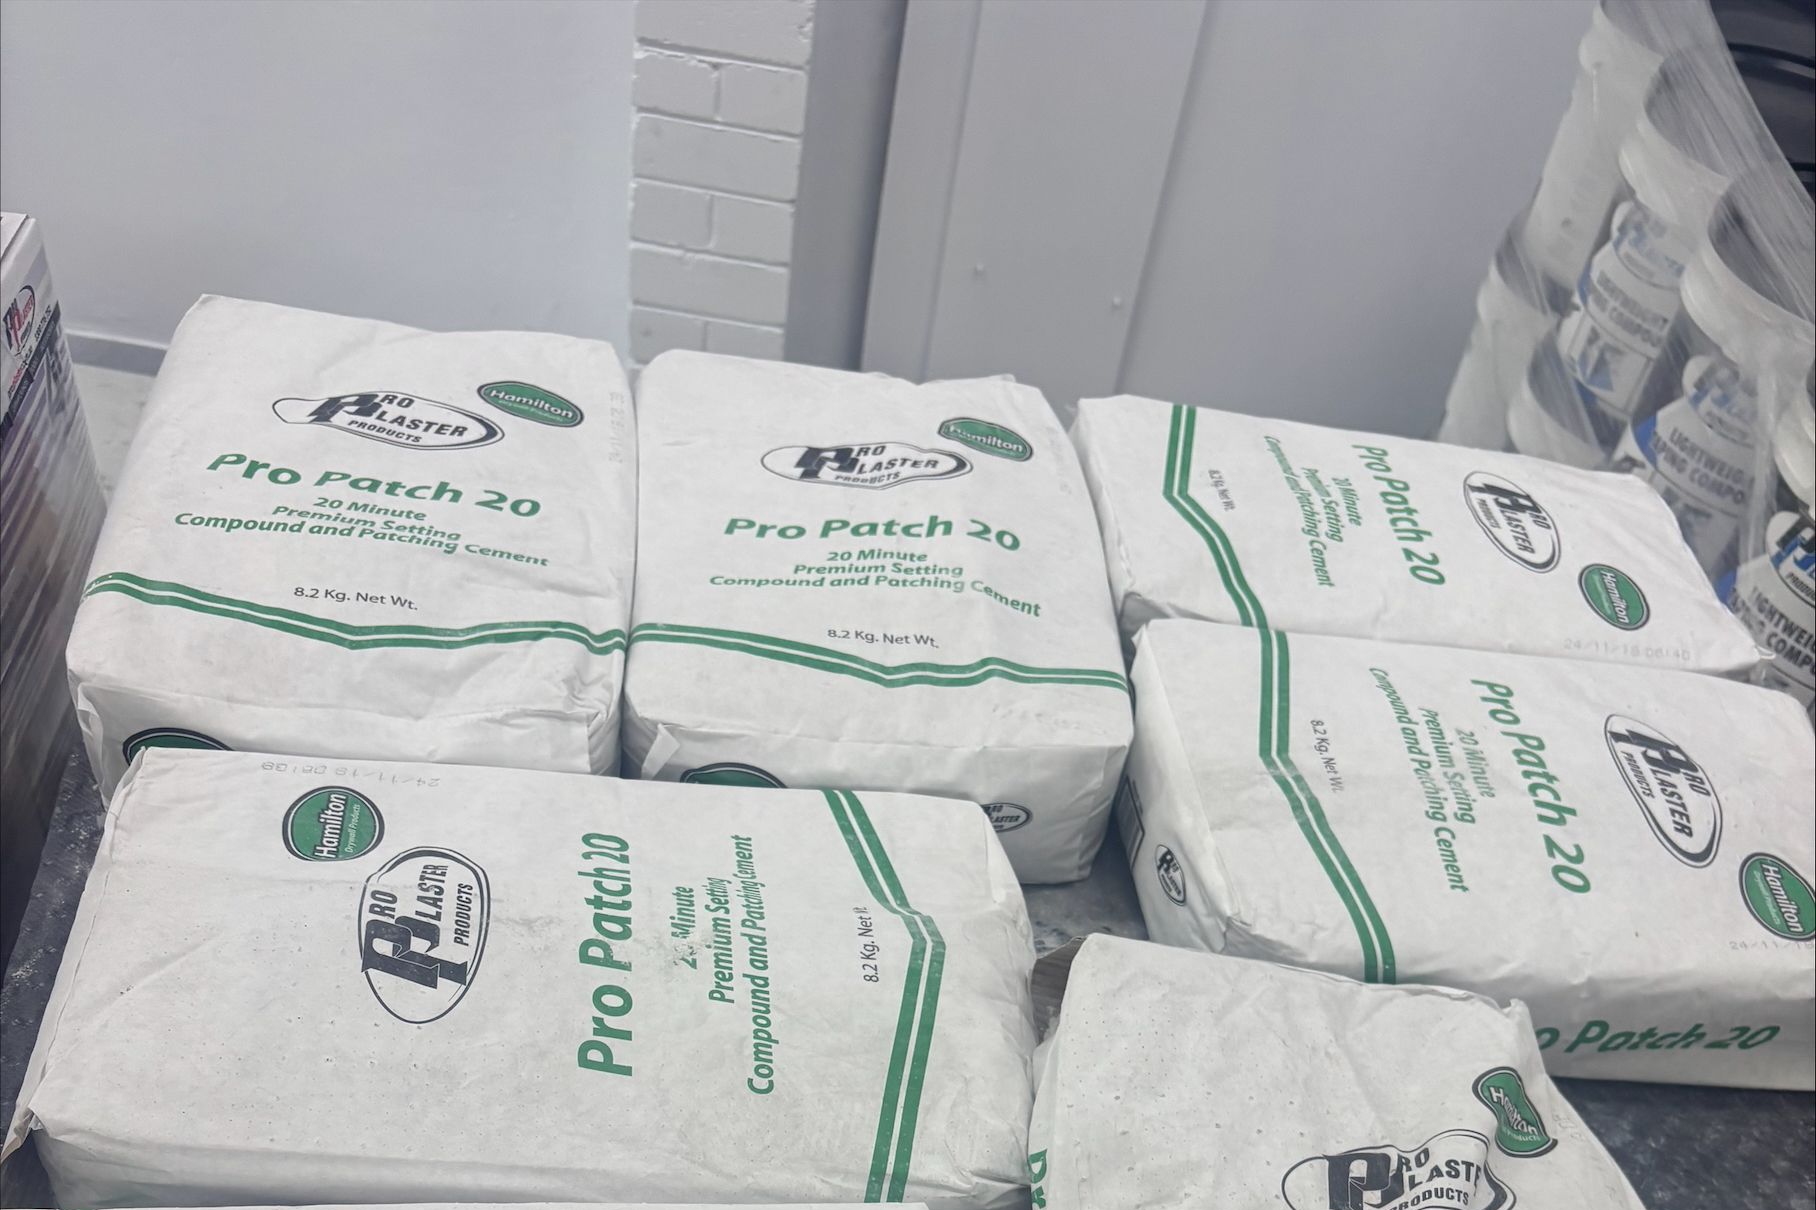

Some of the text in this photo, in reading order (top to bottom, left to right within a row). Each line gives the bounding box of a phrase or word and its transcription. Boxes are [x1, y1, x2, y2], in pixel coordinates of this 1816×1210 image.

[490, 389, 574, 418] Hamilton
[348, 420, 422, 444] PRODUCTS
[206, 453, 542, 518] Pro Patch 20
[272, 505, 462, 542] Premium Setting
[313, 496, 428, 522] 20 Minute
[1351, 443, 1446, 586] Pro Patch 20
[174, 511, 549, 567] Compound and Patching Cement
[724, 515, 1021, 551] Pro Patch 20
[793, 562, 964, 579] Premium Setting
[826, 548, 928, 563] 20 Minute
[1308, 539, 1336, 588] Cement
[293, 587, 419, 612] 8.2 Kg. Net Wt.
[709, 574, 1042, 617] Compound and Patching Cement
[1600, 570, 1629, 624] Hamilton
[827, 629, 940, 649] 8.2 Kg. Net Wt.
[1310, 719, 1328, 736] 8.2
[1313, 737, 1331, 756] Kg.
[1320, 757, 1339, 775] Net
[1368, 667, 1470, 893] Compound and Patching Cement
[1417, 706, 1478, 825] Premium Setting
[1455, 727, 1496, 799] 20 Minute
[1621, 749, 1656, 799] PRODUCTS
[1470, 678, 1592, 894] Pro Patch 20
[314, 792, 349, 859] Hamilton
[453, 882, 474, 947] PRODUCTS
[1761, 863, 1804, 932] Hamilton
[701, 876, 735, 1004] Premium Setting
[857, 915, 875, 938] Net
[577, 832, 634, 1078] Pro Patch 20
[730, 834, 780, 1096] Compound and Patching Cement
[859, 940, 880, 961] Kg.
[861, 963, 880, 983] 8.2
[1562, 1019, 1710, 1054] Patch
[1703, 1025, 1781, 1051] 20
